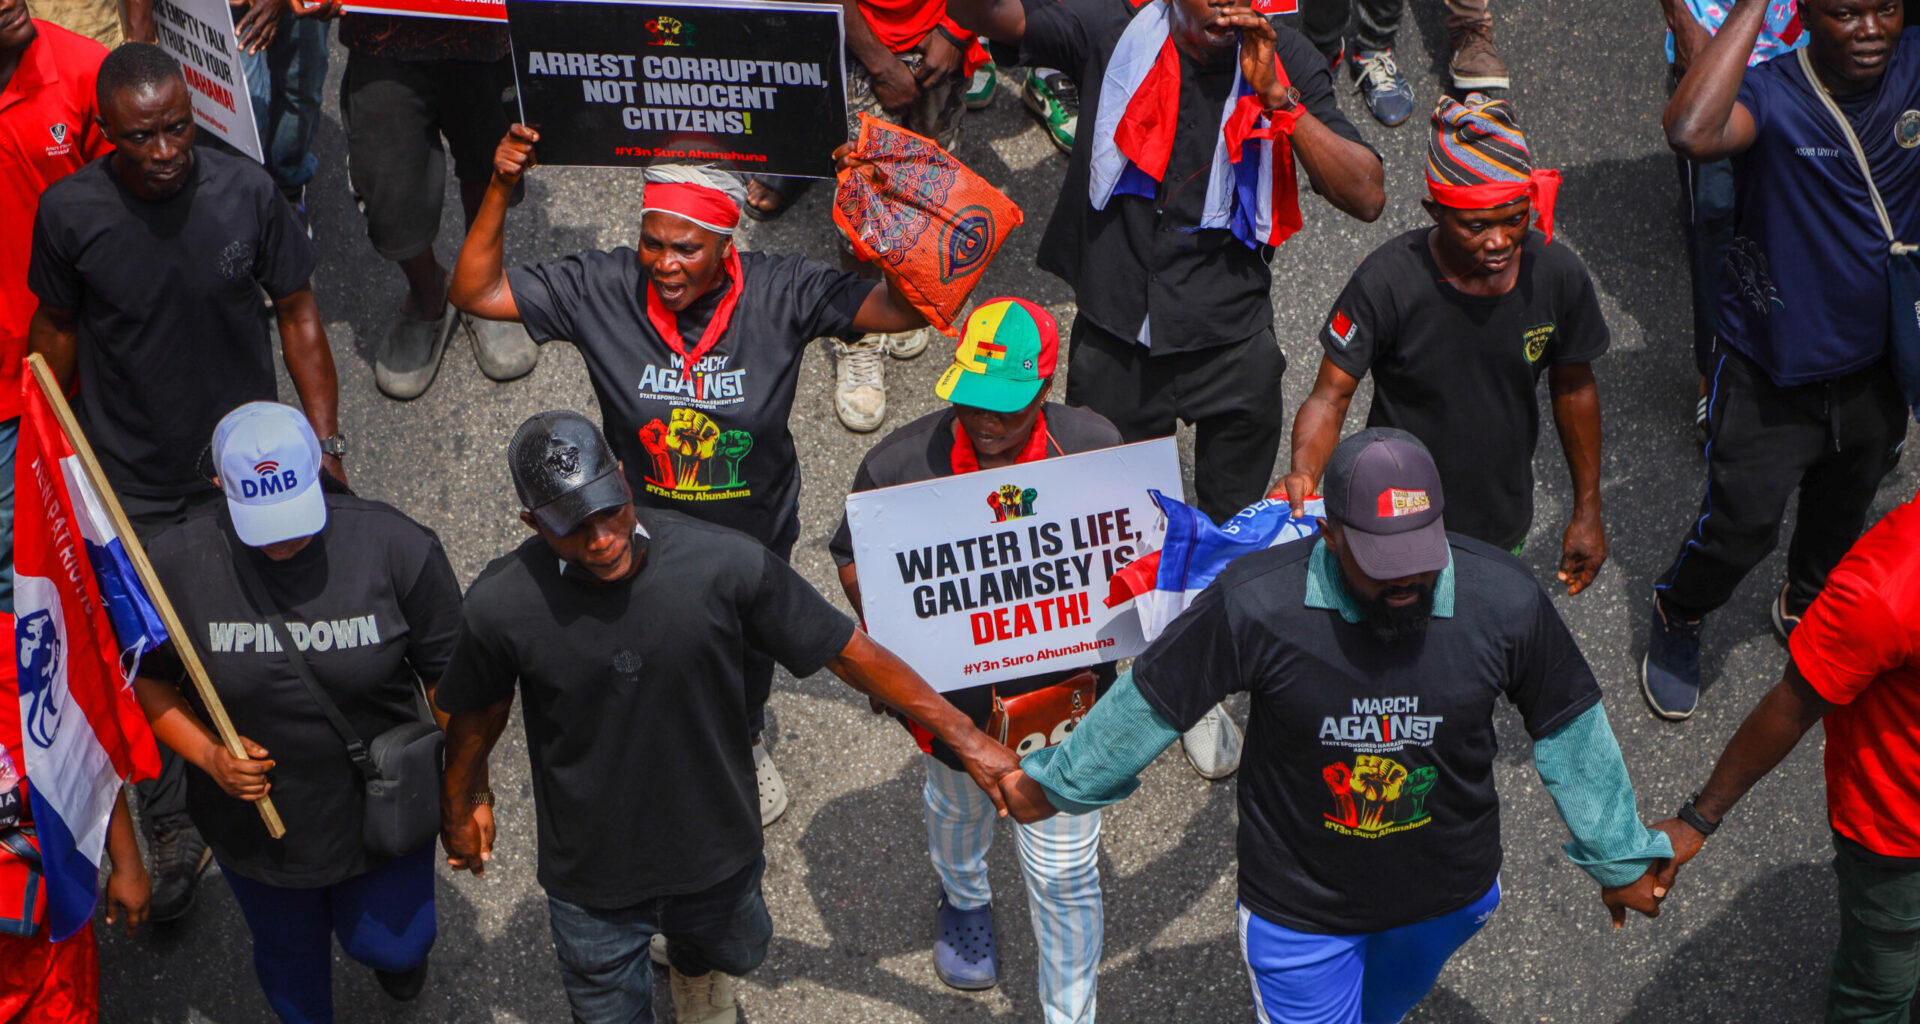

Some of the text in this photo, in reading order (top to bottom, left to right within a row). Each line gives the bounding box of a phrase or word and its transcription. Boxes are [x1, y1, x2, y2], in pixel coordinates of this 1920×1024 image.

[165, 0, 200, 39] EMPTY
[200, 20, 232, 60] TALK,
[160, 23, 188, 58] TRUE
[187, 40, 203, 67] TO
[202, 48, 234, 86] YOUR
[528, 51, 828, 89] ARREST CORRUPTION,
[183, 63, 237, 115] MAHAMA!
[582, 79, 777, 110] NOT INNOCENT
[622, 107, 753, 135] CITIZENS!
[615, 147, 768, 162] #Y3n Suro Ahunahuna
[670, 353, 729, 372] MRCH
[639, 392, 657, 400] STATE
[241, 469, 298, 498] DMB
[646, 484, 751, 501] #Y3n Suro Ahunahuna
[896, 507, 1143, 585] WATER IS LIFE,
[913, 545, 1136, 619] GALAMSEY IS
[970, 591, 1091, 646] DEATH!
[963, 637, 1115, 675] #Y3n Suro Ahunahuna
[1352, 696, 1418, 715] MARCH
[1340, 741, 1377, 749] SPONSORED
[1421, 740, 1434, 748] AND
[1382, 744, 1404, 753] POWER
[1324, 816, 1432, 840] #Y3n Suro Ahunahuna
